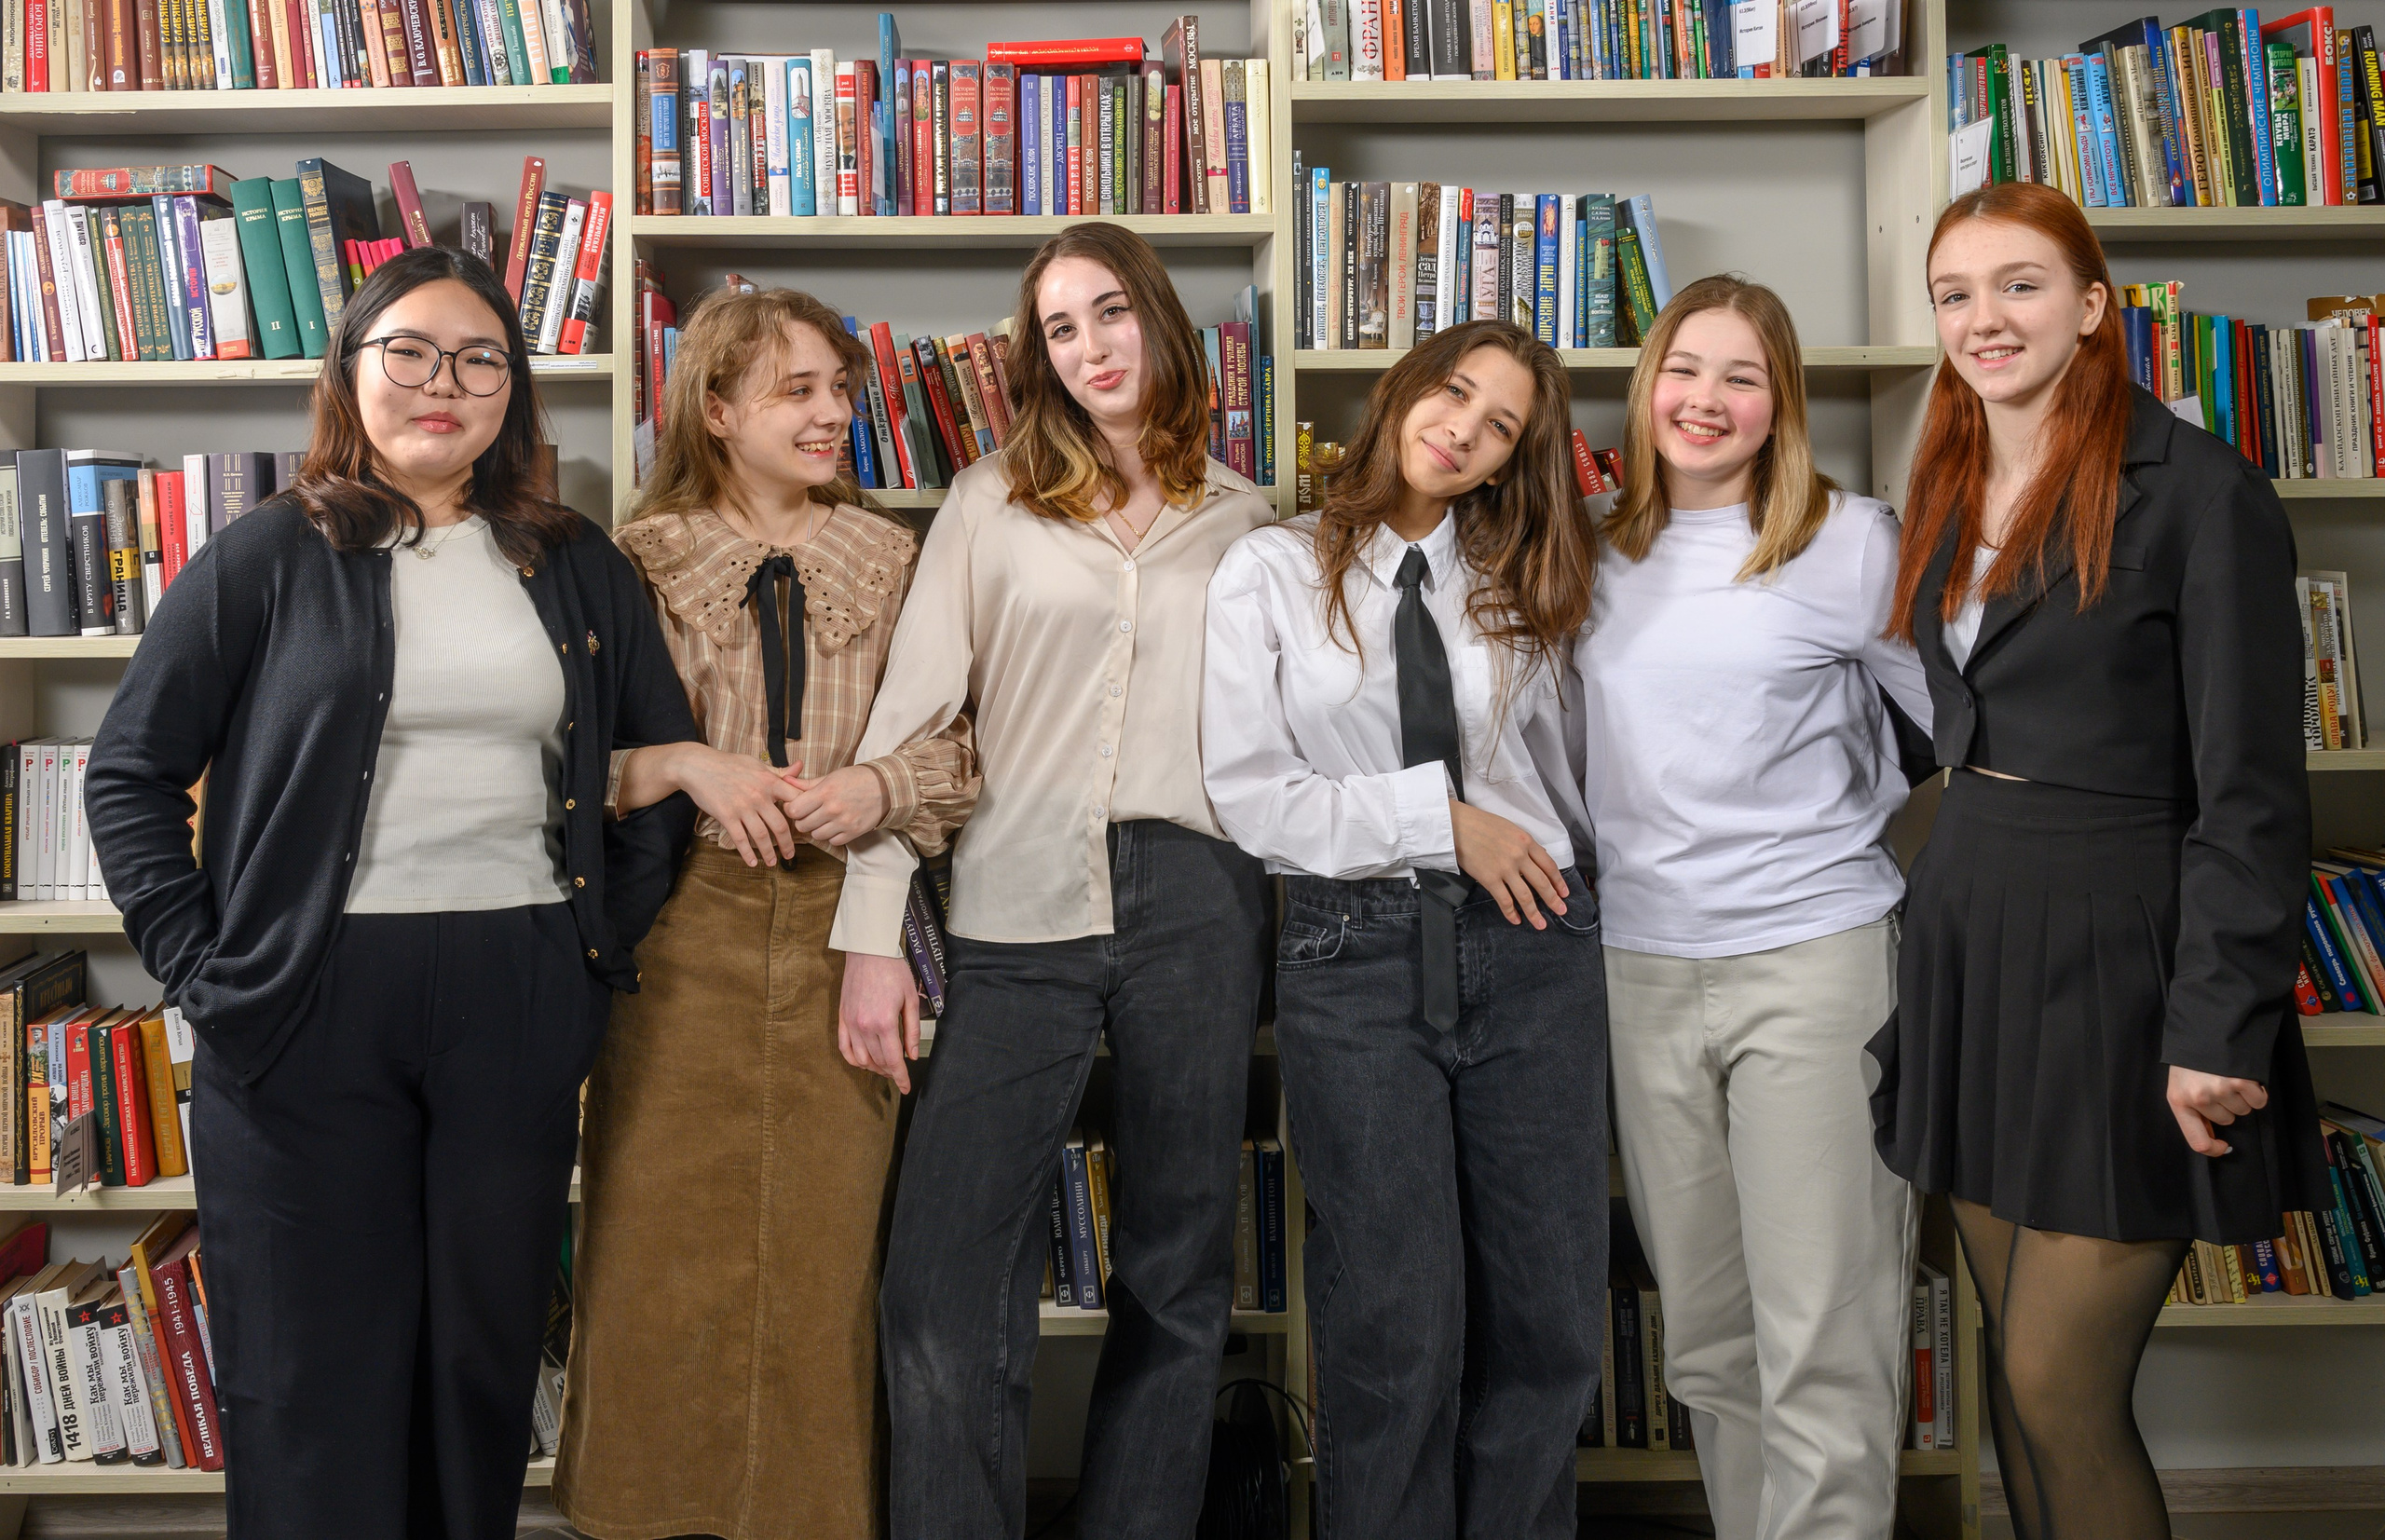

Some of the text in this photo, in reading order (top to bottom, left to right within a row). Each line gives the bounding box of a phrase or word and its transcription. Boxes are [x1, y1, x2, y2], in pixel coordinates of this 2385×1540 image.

[34, 4, 44, 59] БОРОДИНО
[2324, 26, 2334, 65] БОКС
[1185, 25, 1200, 135] мое открытие МОСКВЫ
[2075, 68, 2090, 111] КОЖЕВНИКОВ
[2100, 75, 2110, 104] ЯКУШЕВ
[2200, 57, 2209, 87] МАССИВНЫХ
[2363, 50, 2385, 127] RUNNING MAN
[825, 89, 835, 170] ЧУДЕСНАЯ МОСКВА
[1099, 94, 1111, 142] ОТКРЫТКАХ
[1231, 105, 1239, 140] АРБАТА
[2000, 98, 2010, 138] ФУТБОЛИСТОВ
[2180, 41, 2208, 191] ГЕРОИ ОЛИМПИЙСКИХ ИГР
[2206, 100, 2215, 130] ПРОГРАММЫ
[2248, 29, 2271, 186] ОЛИМПИЙСКИЕ ЧЕМПИОНЫ
[2274, 113, 2283, 146] КЛУБЫ
[2339, 56, 2357, 187] ЭНЦИКЛОПЕДИЯ СПОРТА
[700, 103, 710, 194] СОВЕТСКОЙ МОСКВЫ
[1042, 87, 1051, 206] ВОКРУГ НЕМЕЦКОЙ СЛОБОДЫ
[1056, 132, 1065, 164] ДВОРЕЦ
[2003, 139, 2011, 164] ВЕЛИКИХ
[2037, 130, 2049, 179] КИКБОКСИНГ
[2079, 135, 2095, 198] ПО ТОНКОМУ ЛЬДУ
[2210, 131, 2218, 155] БАЗОВЫЕ
[2308, 128, 2316, 152] КАРАТЭ
[1028, 166, 1036, 202] МОСКОВСКИЕ
[1070, 148, 1080, 211] РУБЛЕВКА
[1085, 148, 1094, 202] МОСКОВСКИЕ УГЛЫ
[1100, 151, 1112, 199] СОКОЛЬНИКИ
[242, 208, 268, 217] ИСТОРИЯ
[278, 207, 304, 216] ИСТОРИЯ
[584, 201, 600, 252] НЕИЗБЕЖНОСТЬ?
[591, 207, 606, 253] ИСТОРИЧЕСКАЯ
[1365, 212, 1373, 257] Петербургские
[1371, 198, 1380, 237] фабриканты
[1316, 200, 1327, 340] ПУШКИН, ПАВЛОВСК, ПЕТРОДВОРЕЦ
[1397, 211, 1409, 320] ТВОИ ГЕРОИ, ЛЕНИНГРАД
[130, 263, 144, 337] ИСТОРИЯ ОТЕЧЕСТВА
[147, 263, 162, 337] ИСТОРИЯ ОТЕЧЕСТВА
[271, 320, 281, 331] II
[1538, 265, 1555, 342] ЦАРСКИЕ ДАЧИ
[2331, 307, 2371, 318] ЧЕЛОВЕК
[1236, 342, 1248, 406] СТАРОЙ МОСКВЫ
[2331, 354, 2341, 408] ЮБИЛЕЙНЫХ
[872, 390, 889, 443] Открытие
[1264, 394, 1274, 464] ТРОИЦЕ-СЕРГИЕВА
[2334, 409, 2345, 471] КАЛЕЙДОСКОП
[2350, 414, 2359, 452] ПРАЗДНИК
[38, 494, 51, 593] СЕРГЕЙ ЧУПРИНИН ОТТЕПЕЛЬ: СОБЫТИЯ
[108, 500, 118, 544] ФАТЛАНД
[116, 515, 124, 542] Эрика
[82, 525, 92, 580] СВЕРСТНИКОВ
[86, 582, 94, 606] КРУГУ
[114, 550, 127, 613] ГРАНИЦА
[2325, 685, 2340, 746] СЛАВА РОДУ!
[4, 793, 13, 879] КОММУНАЛЬНАЯ КВАРТИРА
[912, 879, 944, 961] ПУТИН БИОГРАФИЯ
[80, 1070, 89, 1112] ЗАГОВОРЩИКА
[1074, 1180, 1088, 1239] МУССОЛИНИ
[1242, 1215, 1249, 1223] П.
[1267, 1178, 1277, 1242] ВАШИНГТОН
[1051, 1210, 1066, 1278] ФЕРРЕРО ЮЛИЙ
[163, 1277, 185, 1336] 1941-1945
[1915, 1296, 1926, 1334] ПРАВА
[1940, 1316, 1948, 1329] НЕ
[86, 1326, 107, 1402] пережили войну
[116, 1327, 140, 1403] пережили войну
[1940, 1330, 1949, 1364] ХОТЕЛА
[54, 1348, 81, 1451] 1418 ДНЕЙ ВОЙНЫ
[86, 1364, 100, 1405] Как мы
[119, 1365, 133, 1406] Как мы
[182, 1351, 214, 1458] ВЕЛИКАЯ ПОБЕДА
